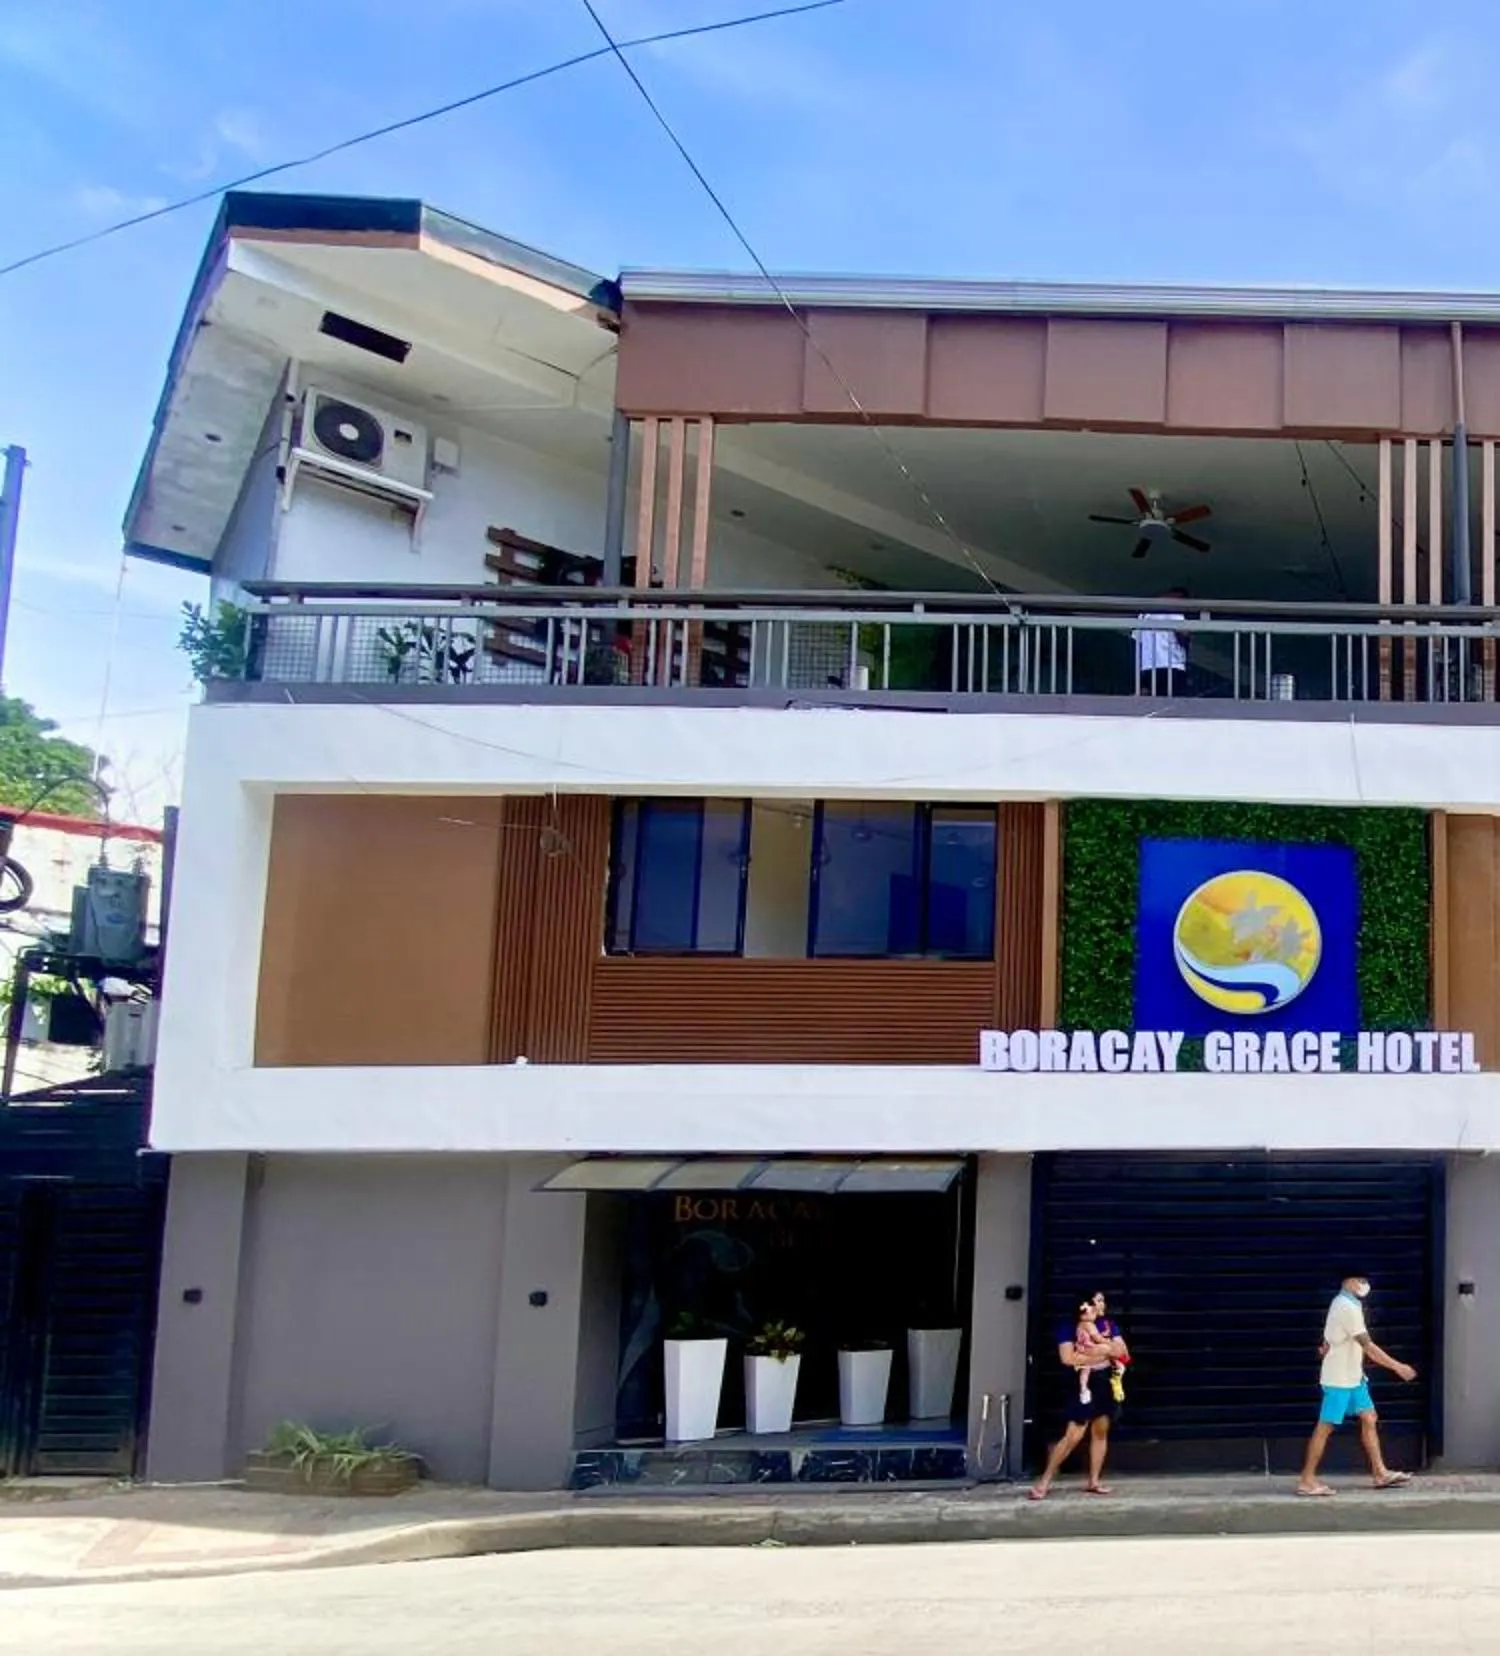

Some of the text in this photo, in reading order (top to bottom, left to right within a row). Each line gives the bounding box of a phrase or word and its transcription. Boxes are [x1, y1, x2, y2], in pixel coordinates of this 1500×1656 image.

[979, 1029, 1481, 1074] BORACAY GRACE HOTEL
